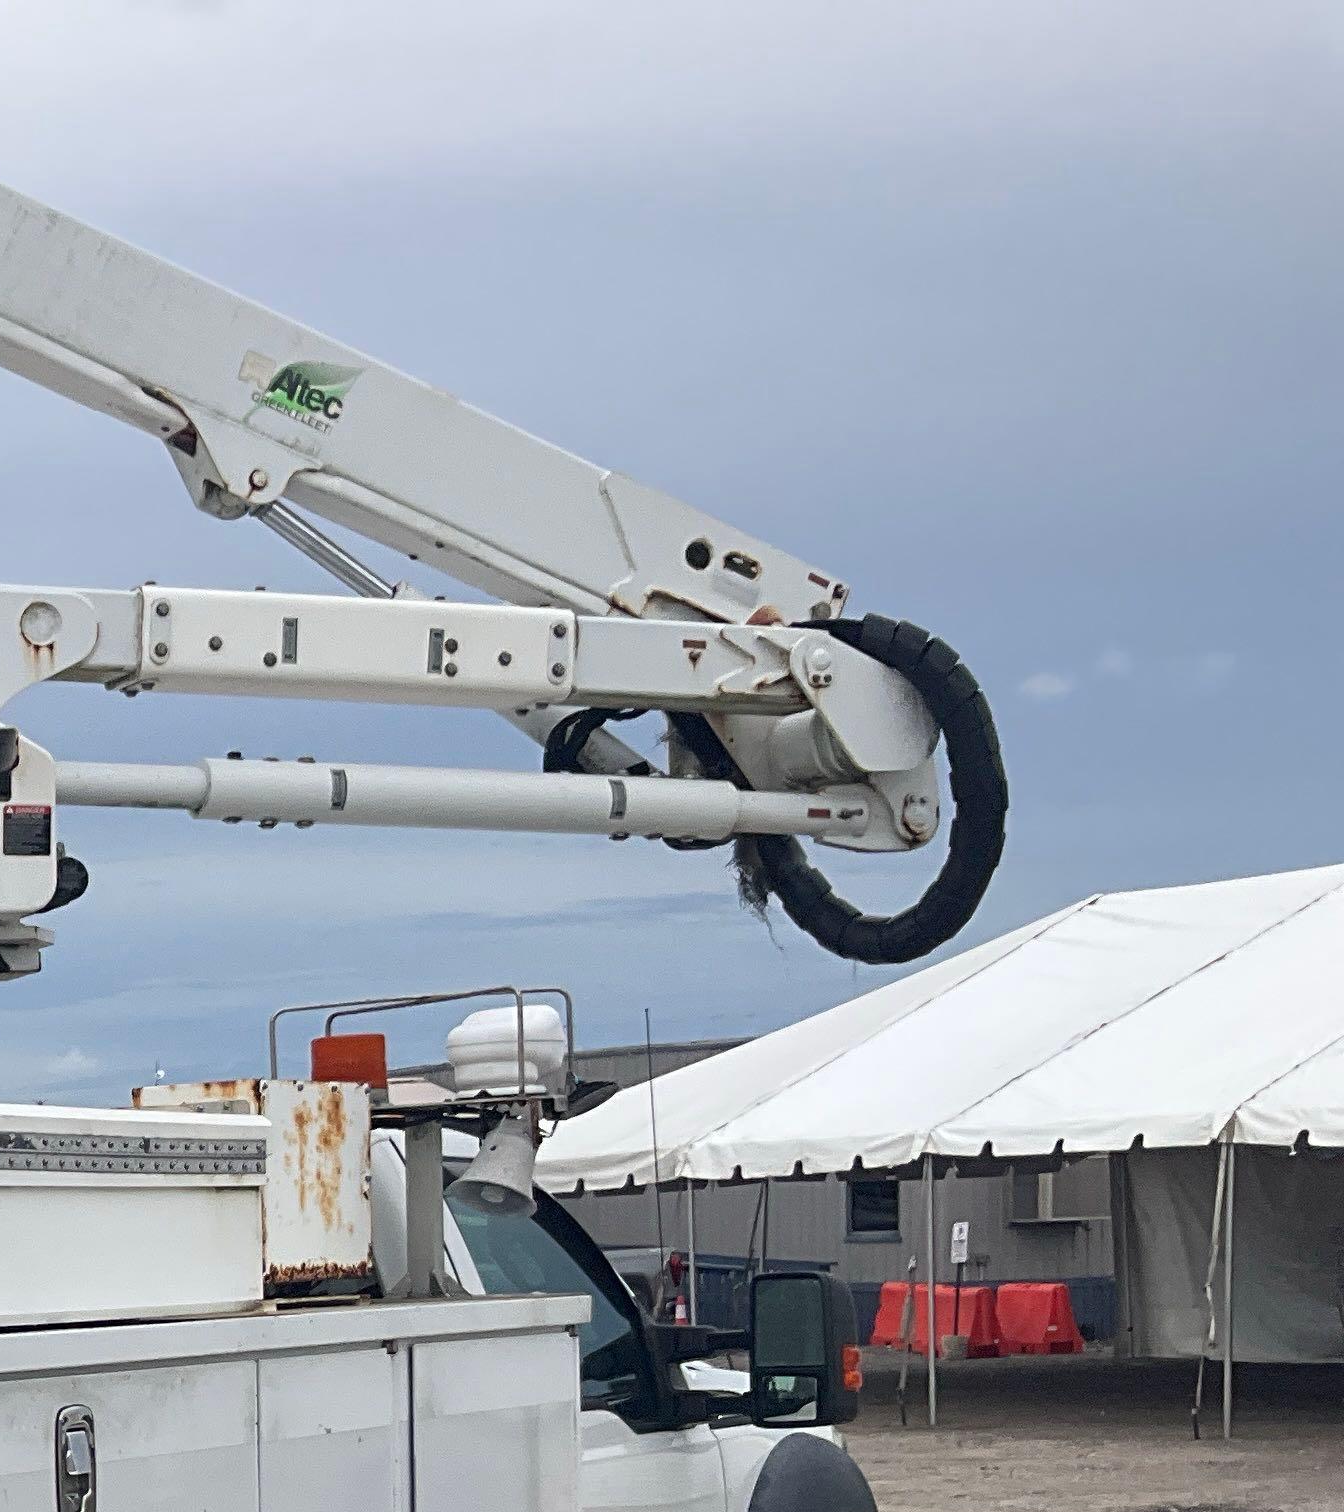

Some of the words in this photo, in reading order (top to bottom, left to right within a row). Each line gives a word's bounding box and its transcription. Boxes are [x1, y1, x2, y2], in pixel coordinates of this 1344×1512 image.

[252, 392, 290, 417] GREEN
[292, 410, 332, 433] FLEET
[266, 367, 344, 420] Altec
